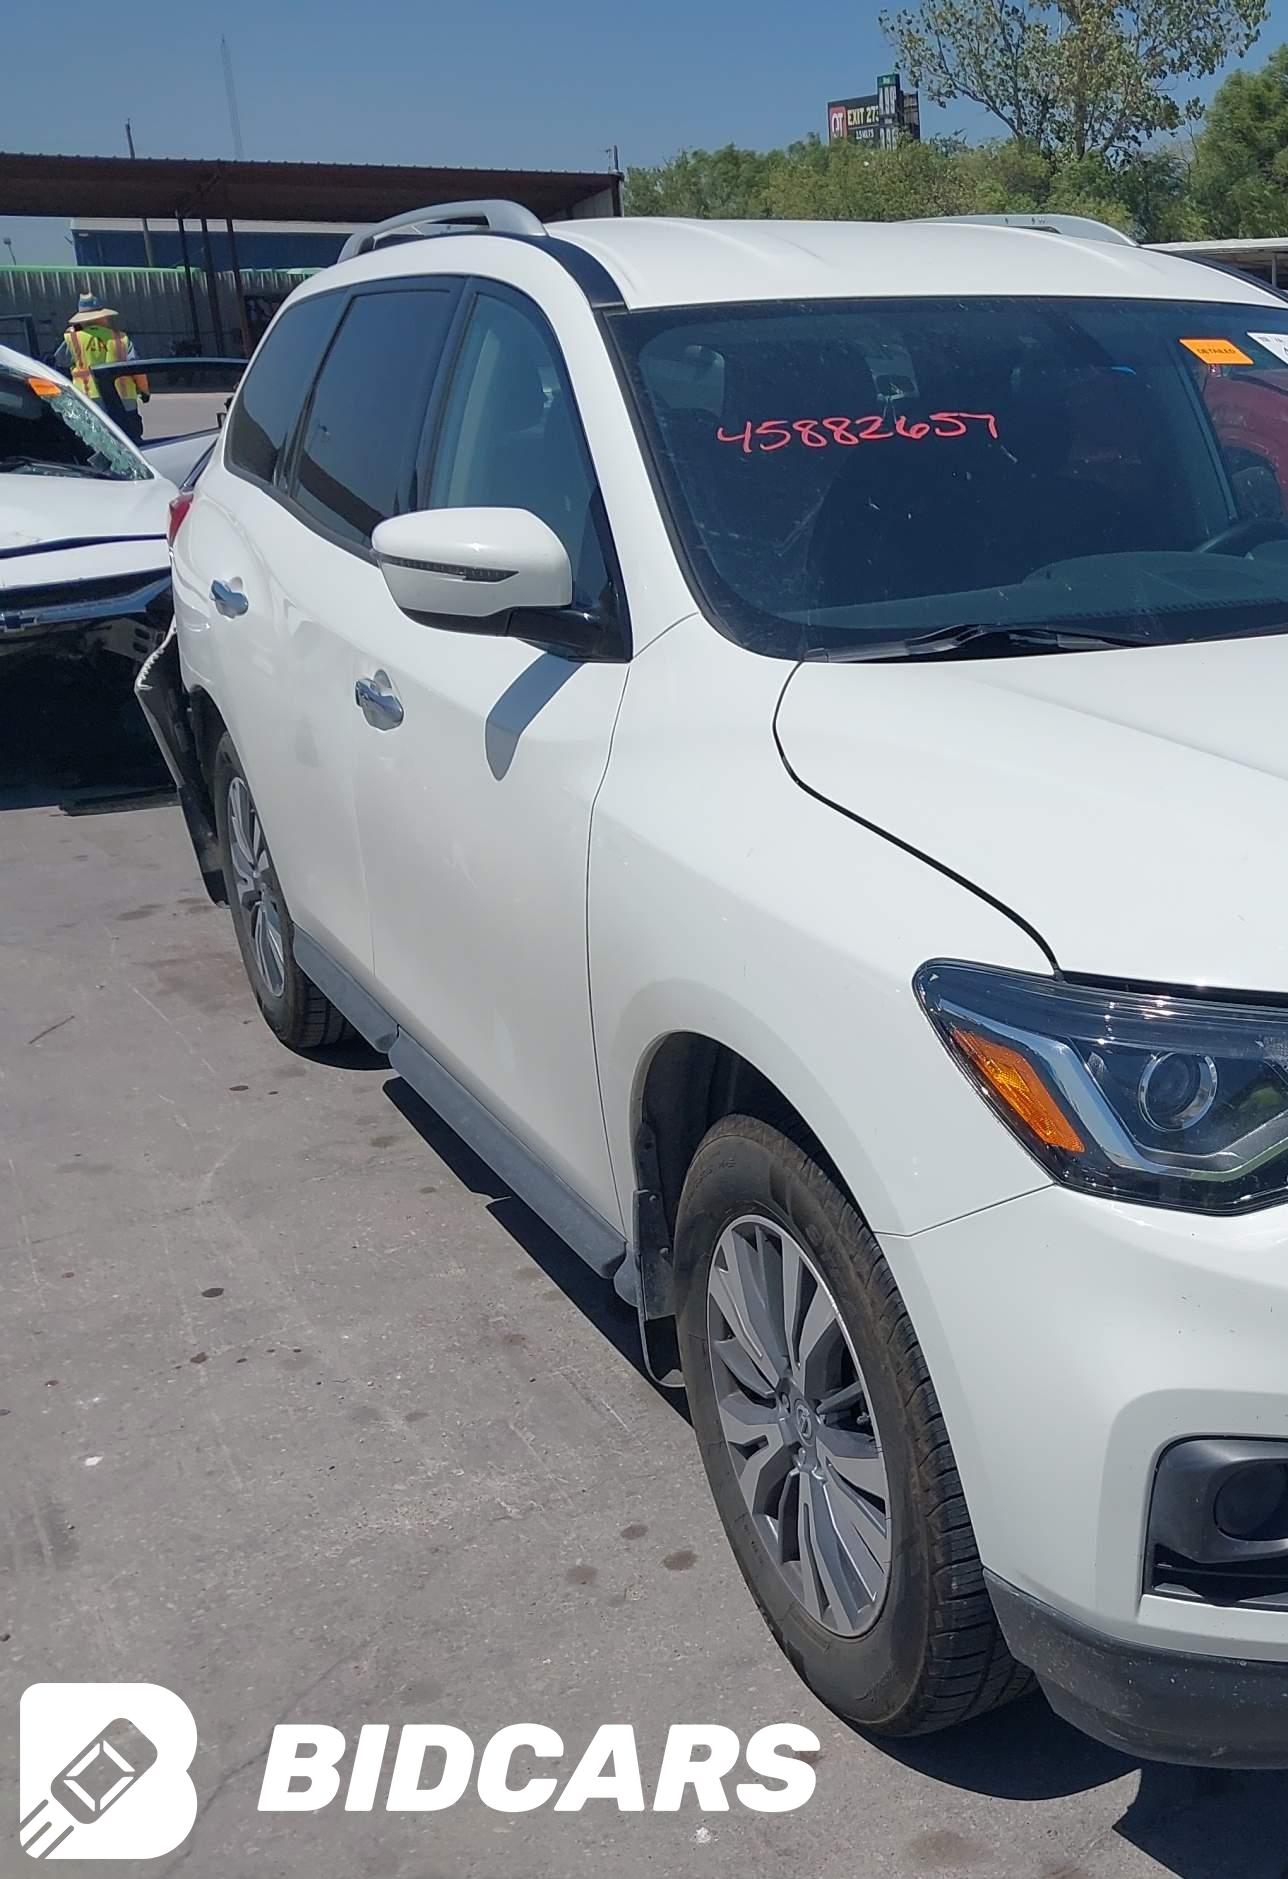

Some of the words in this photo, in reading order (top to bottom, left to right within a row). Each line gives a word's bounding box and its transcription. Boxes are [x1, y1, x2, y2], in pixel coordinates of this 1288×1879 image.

[831, 112, 844, 138] QT
[847, 107, 865, 126] EXIT
[717, 412, 998, 453] 45882657
